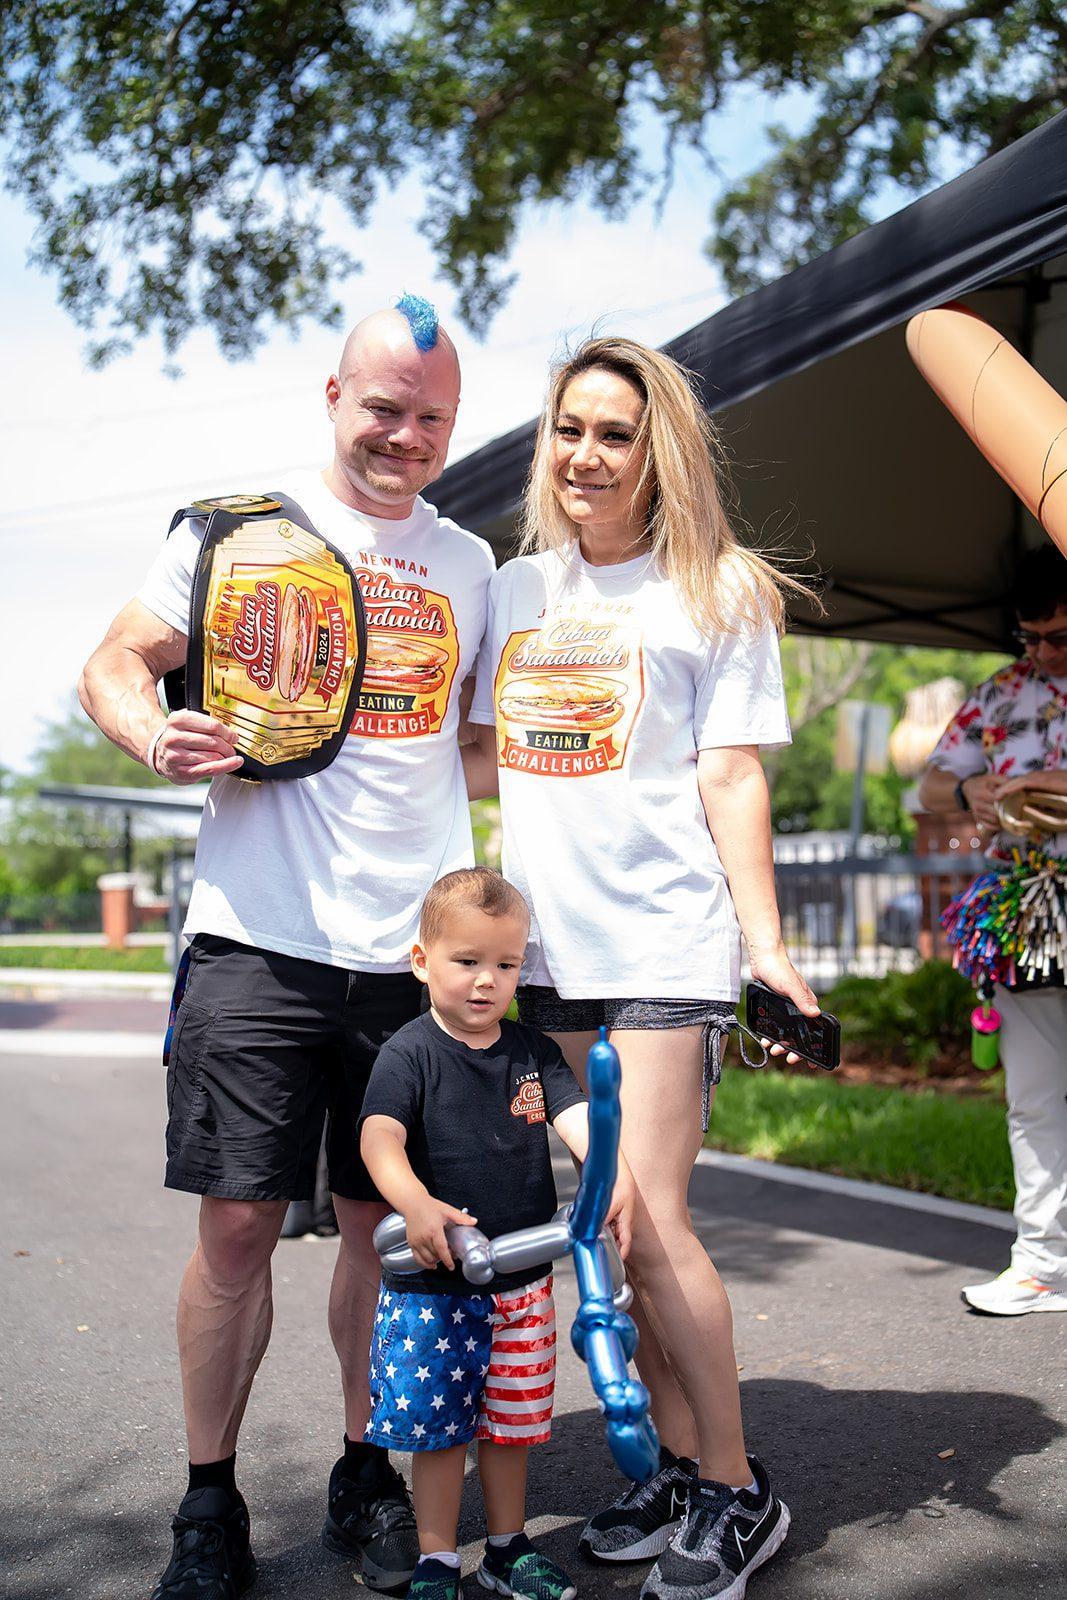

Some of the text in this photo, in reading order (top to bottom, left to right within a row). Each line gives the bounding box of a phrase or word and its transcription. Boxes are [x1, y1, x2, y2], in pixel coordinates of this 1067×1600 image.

[358, 551, 429, 578] NEWMAN
[233, 598, 262, 660] Cuban
[365, 608, 443, 632] ndwich
[251, 585, 277, 686] Sandwich
[318, 632, 329, 661] 2024
[326, 612, 345, 688] CHAMPION
[513, 642, 625, 667] Sandwich
[359, 695, 406, 711] EATING
[353, 715, 428, 734] ALLENGE
[534, 734, 584, 749] EATING
[508, 750, 605, 773] CHALLENGE
